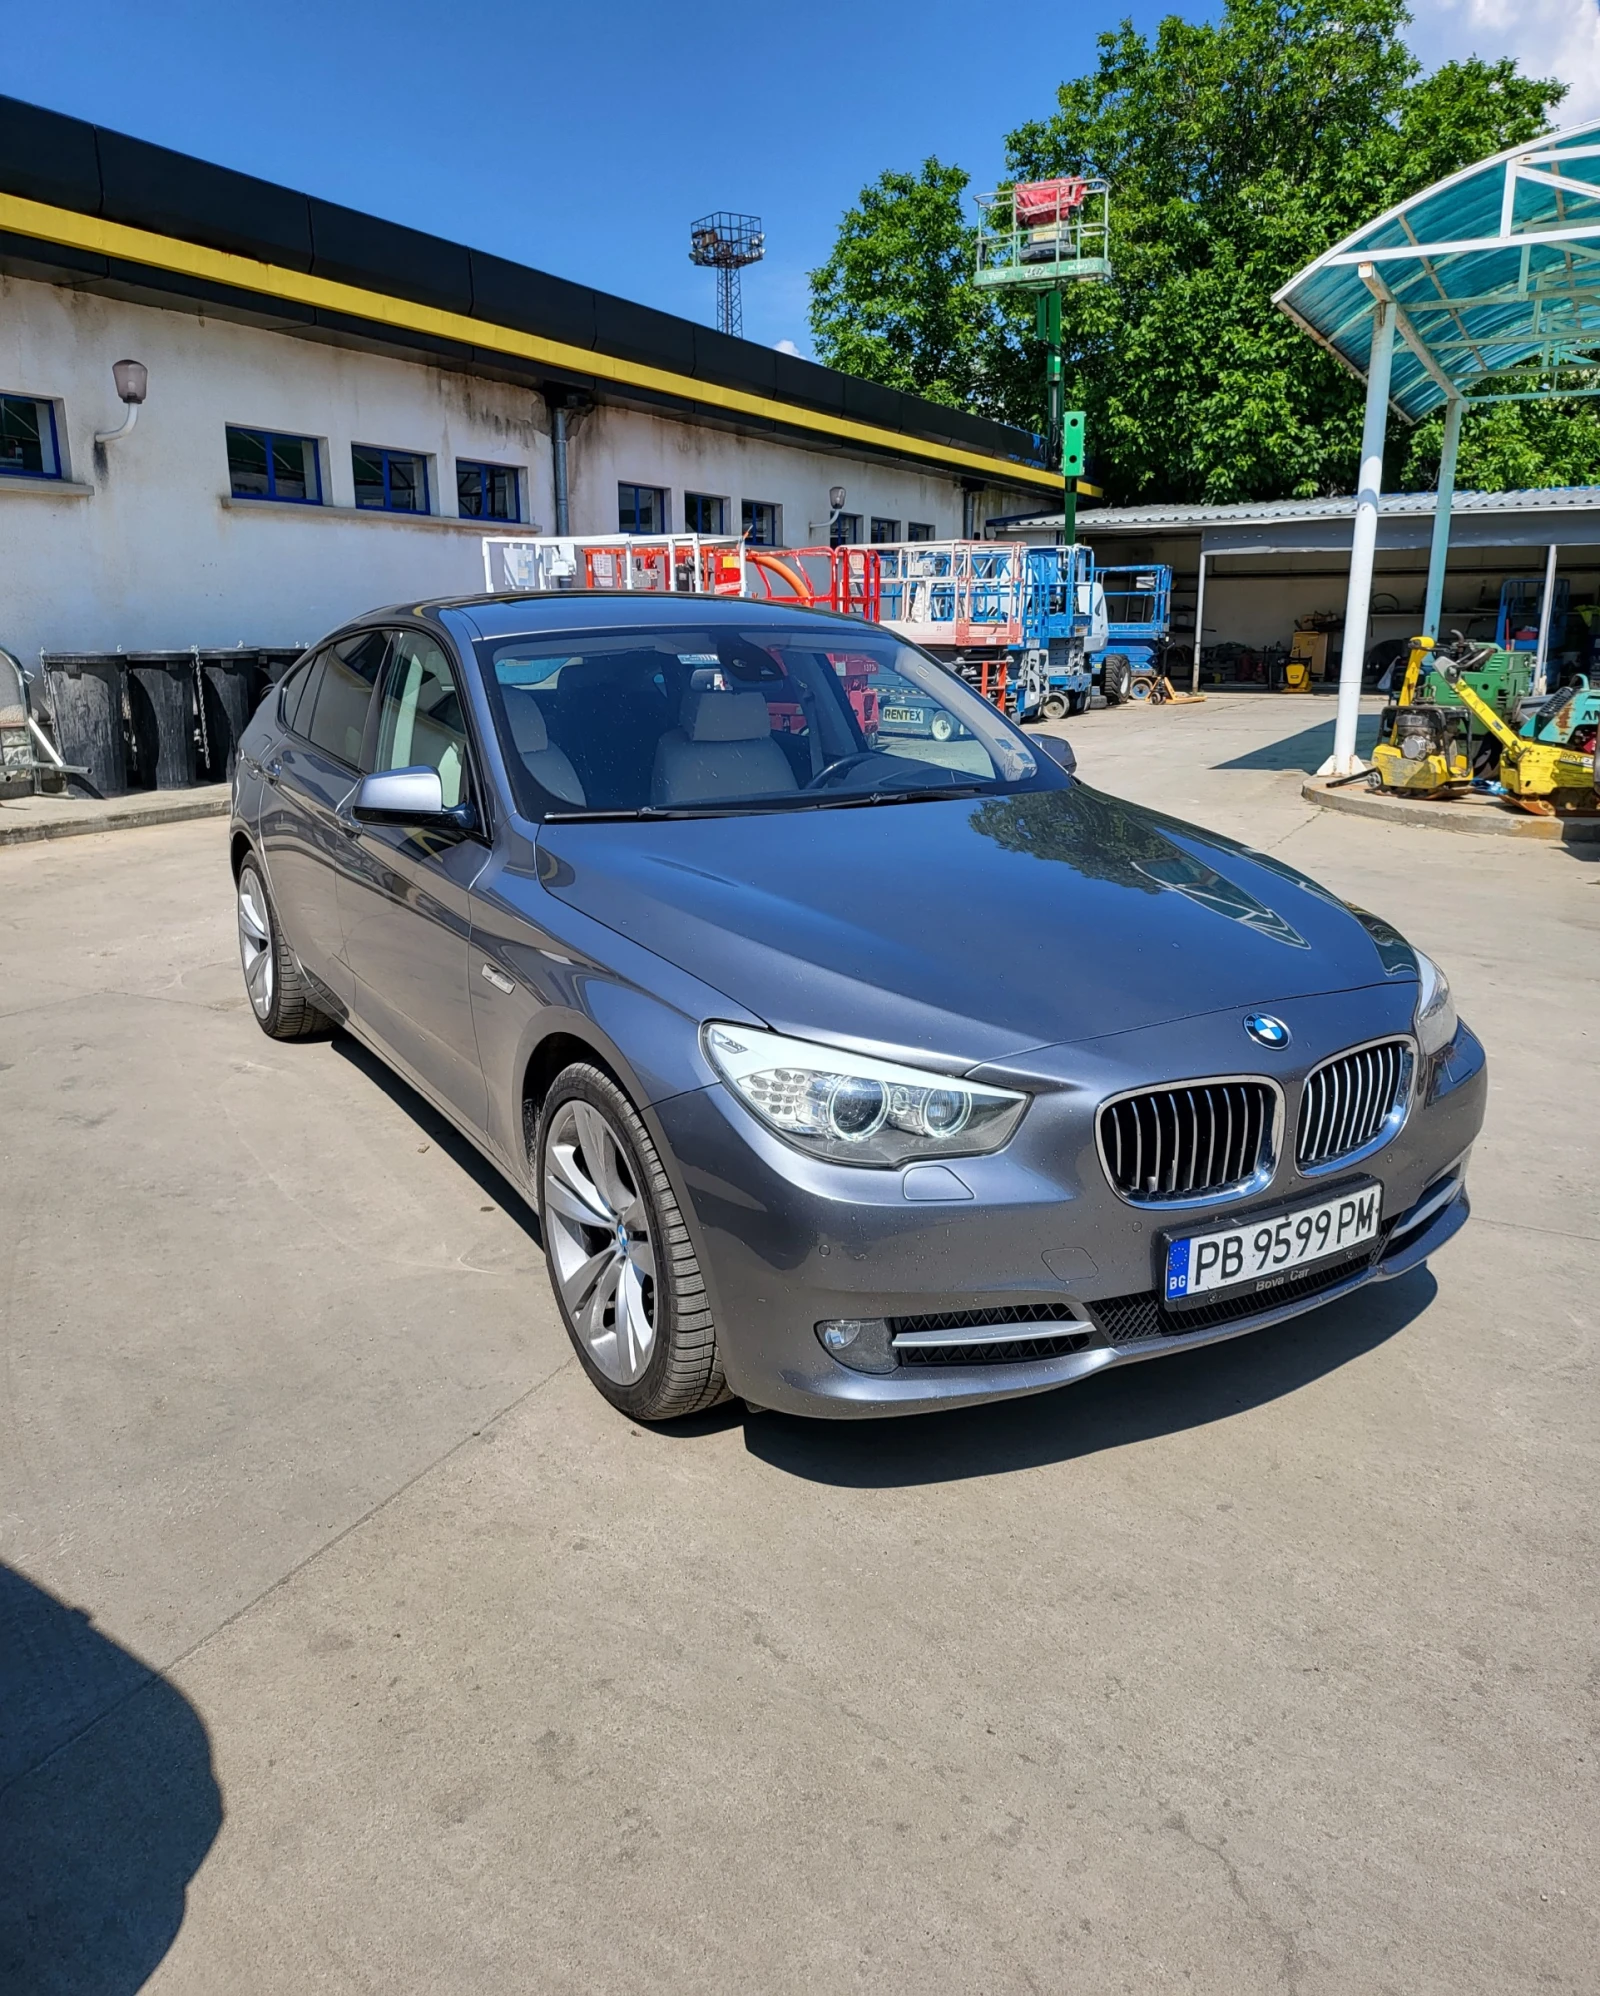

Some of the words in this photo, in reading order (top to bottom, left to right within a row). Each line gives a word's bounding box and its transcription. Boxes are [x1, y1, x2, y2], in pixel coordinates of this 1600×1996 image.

[884, 708, 921, 721] RENTEX
[1195, 1235, 1244, 1287] PB
[1253, 1209, 1332, 1271] 9599
[1336, 1193, 1375, 1244] PM
[1169, 1275, 1187, 1290] BG
[1255, 1275, 1285, 1292] Bova
[1289, 1267, 1311, 1281] Car
